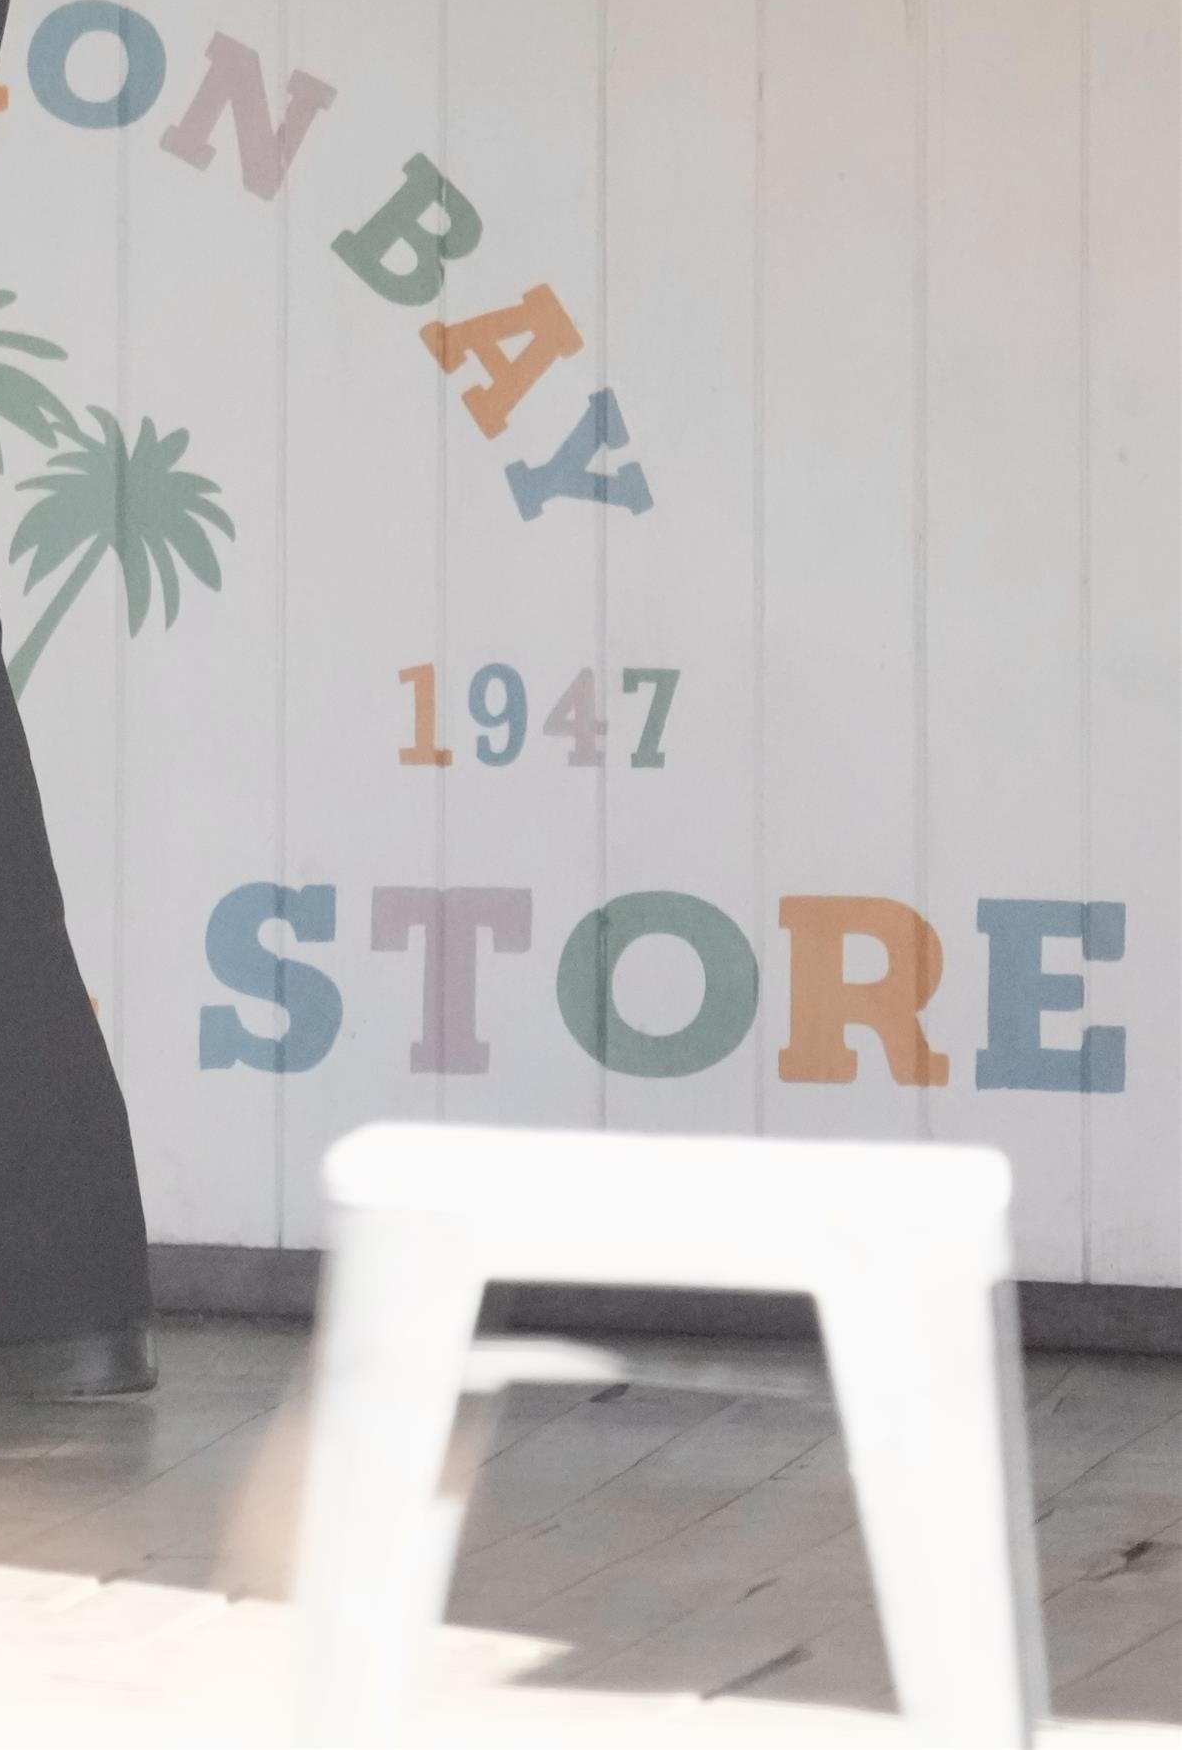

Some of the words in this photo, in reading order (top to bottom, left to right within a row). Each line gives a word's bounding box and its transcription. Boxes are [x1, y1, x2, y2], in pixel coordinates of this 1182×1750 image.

[330, 151, 654, 522] BAY
[397, 662, 681, 769] 1947
[198, 880, 1128, 1093] STORE
